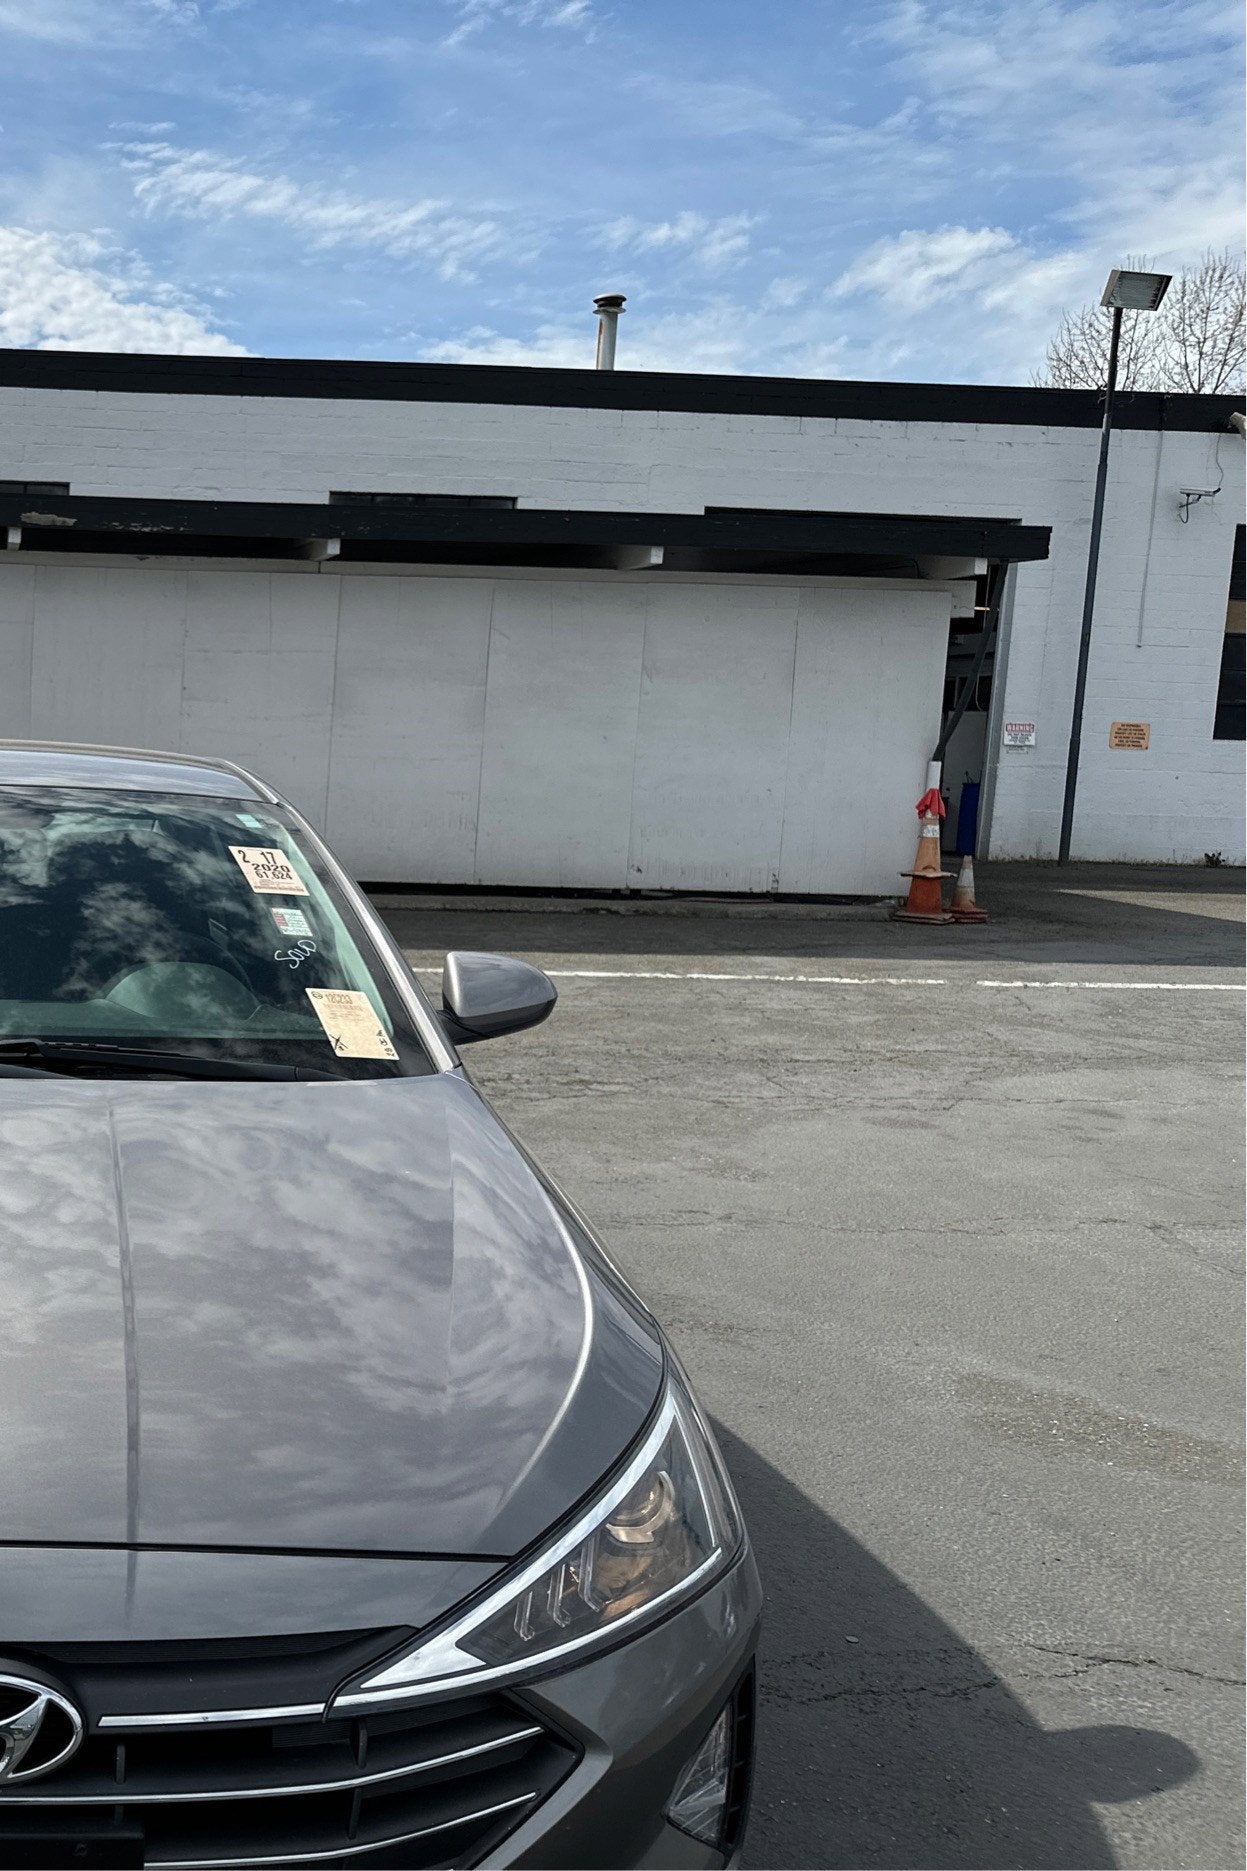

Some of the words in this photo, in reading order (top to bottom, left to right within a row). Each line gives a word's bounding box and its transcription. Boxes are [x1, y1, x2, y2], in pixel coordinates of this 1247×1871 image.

[237, 849, 250, 863] 2
[260, 851, 277, 865] 17
[251, 863, 291, 873] 2020
